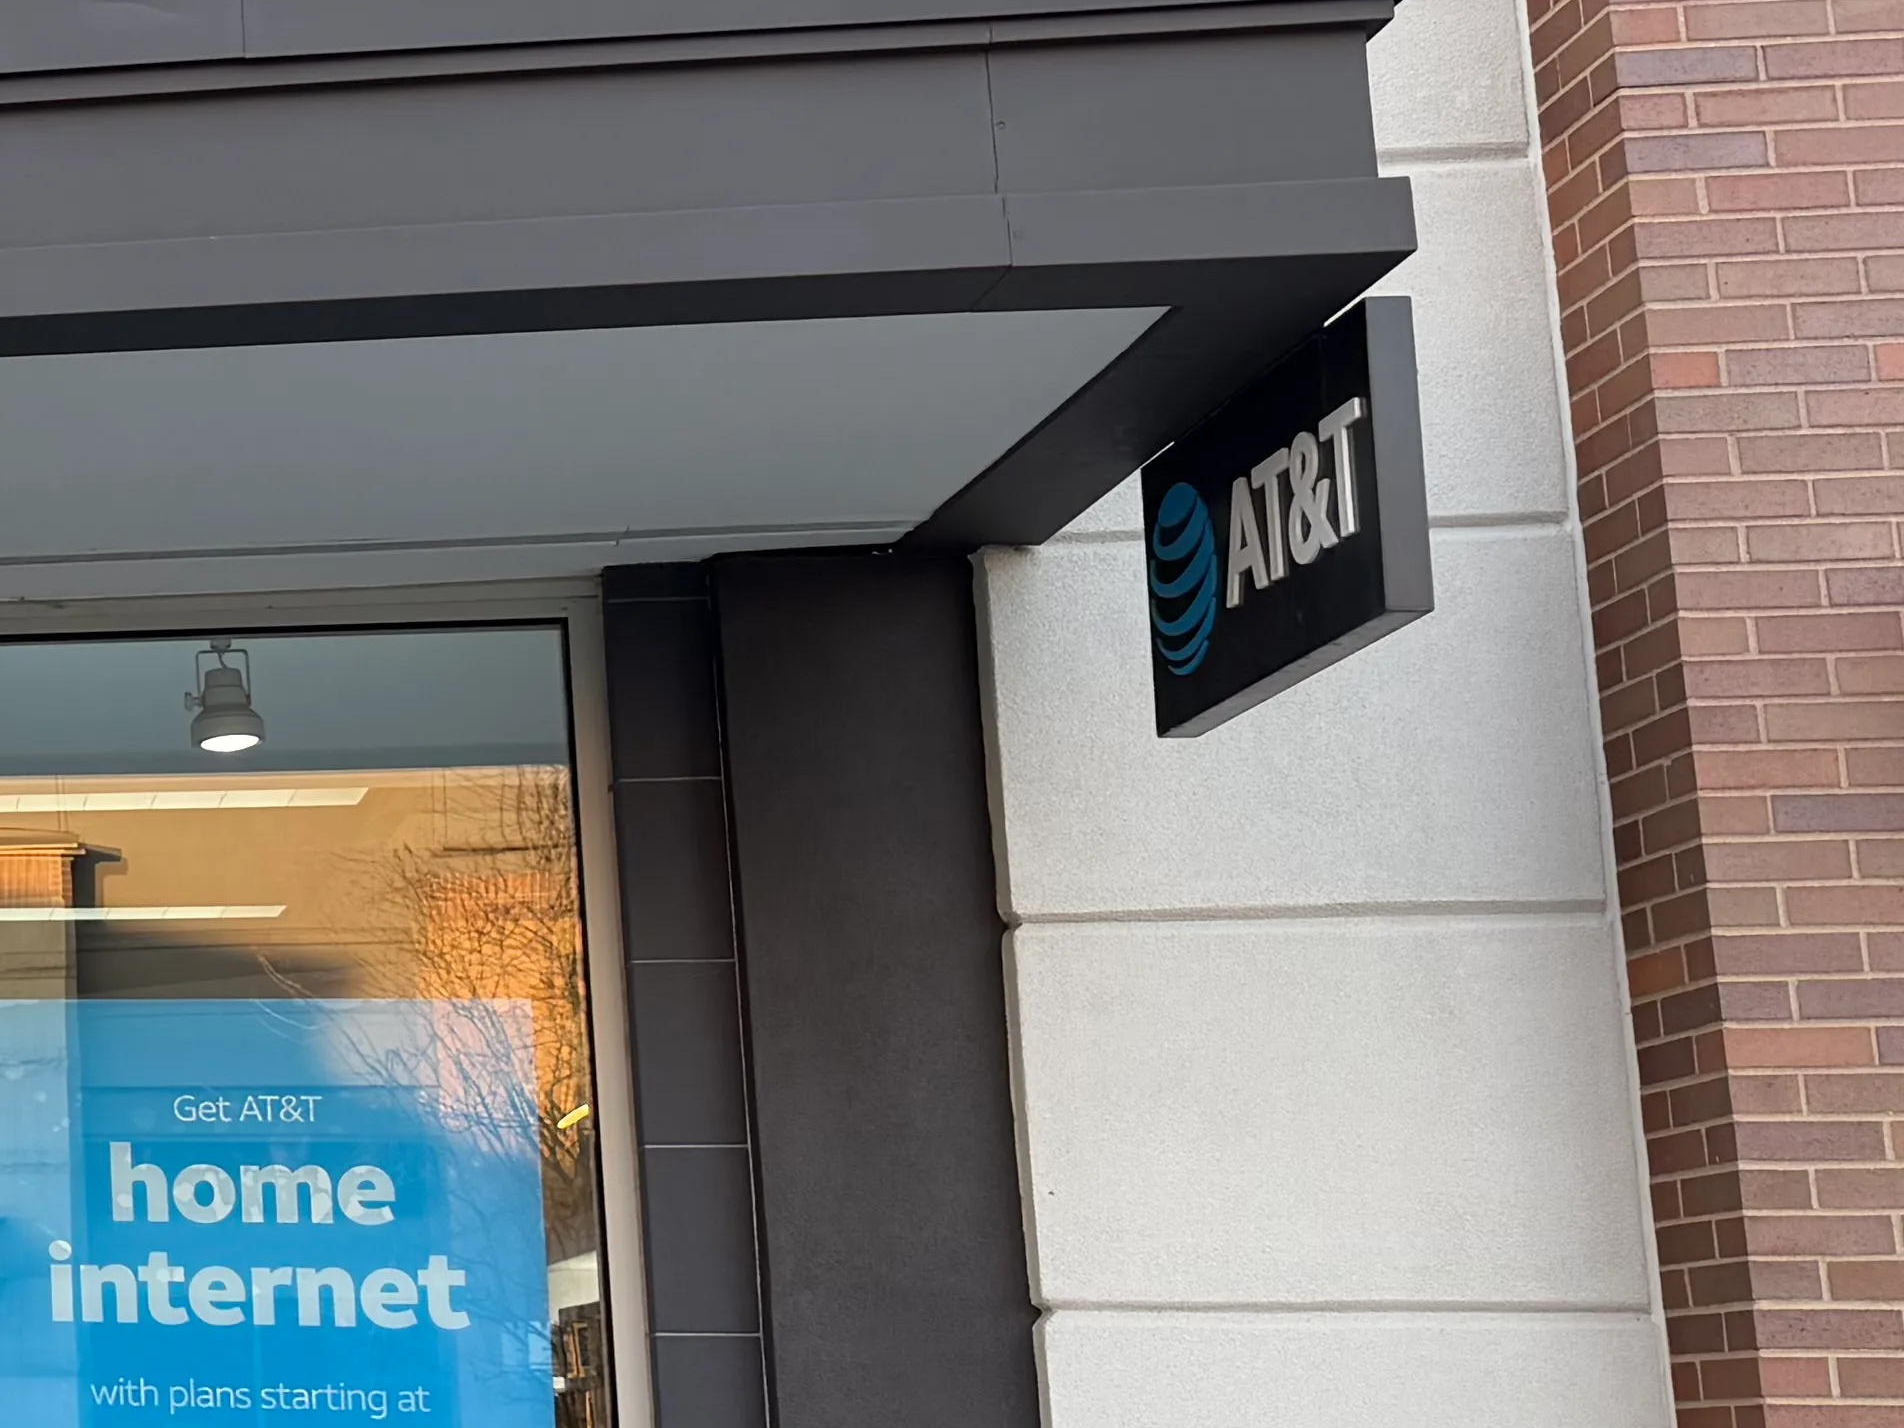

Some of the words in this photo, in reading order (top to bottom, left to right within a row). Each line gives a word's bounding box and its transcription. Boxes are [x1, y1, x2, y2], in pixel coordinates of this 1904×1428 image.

[1226, 396, 1366, 608] AT&T
[173, 1094, 232, 1122] Get
[239, 1094, 323, 1123] AT&T
[109, 1141, 396, 1226] home
[48, 1239, 472, 1330] internet
[91, 1378, 159, 1408] with
[169, 1378, 252, 1414] plans
[260, 1381, 388, 1419] starting
[397, 1385, 432, 1413] at
